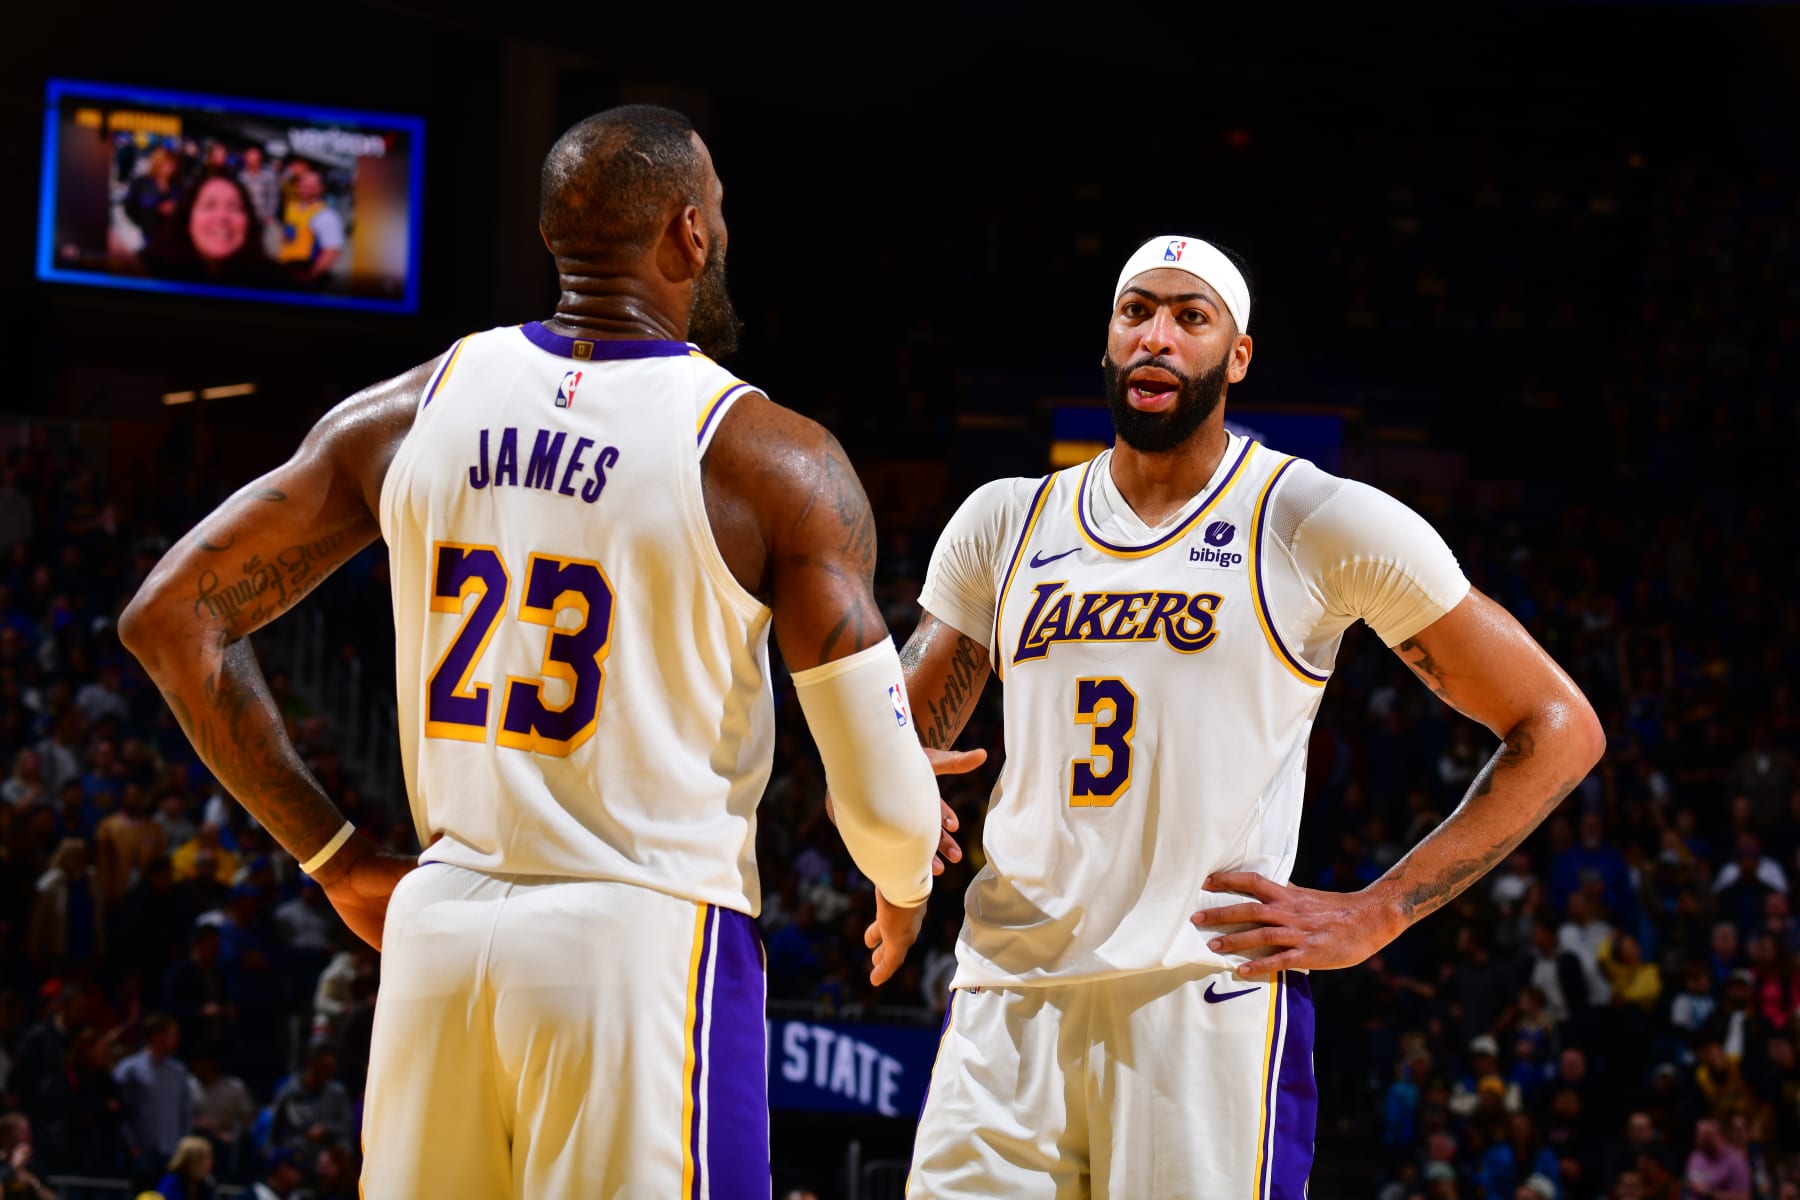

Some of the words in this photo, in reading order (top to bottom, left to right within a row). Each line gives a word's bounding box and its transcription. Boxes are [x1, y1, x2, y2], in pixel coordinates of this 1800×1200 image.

[469, 427, 620, 504] JAMES
[1189, 547, 1242, 568] bibigo
[425, 540, 617, 758] 23
[1012, 579, 1225, 667] LAKERS
[1069, 676, 1139, 808] 3
[780, 1019, 904, 1119] STATE
